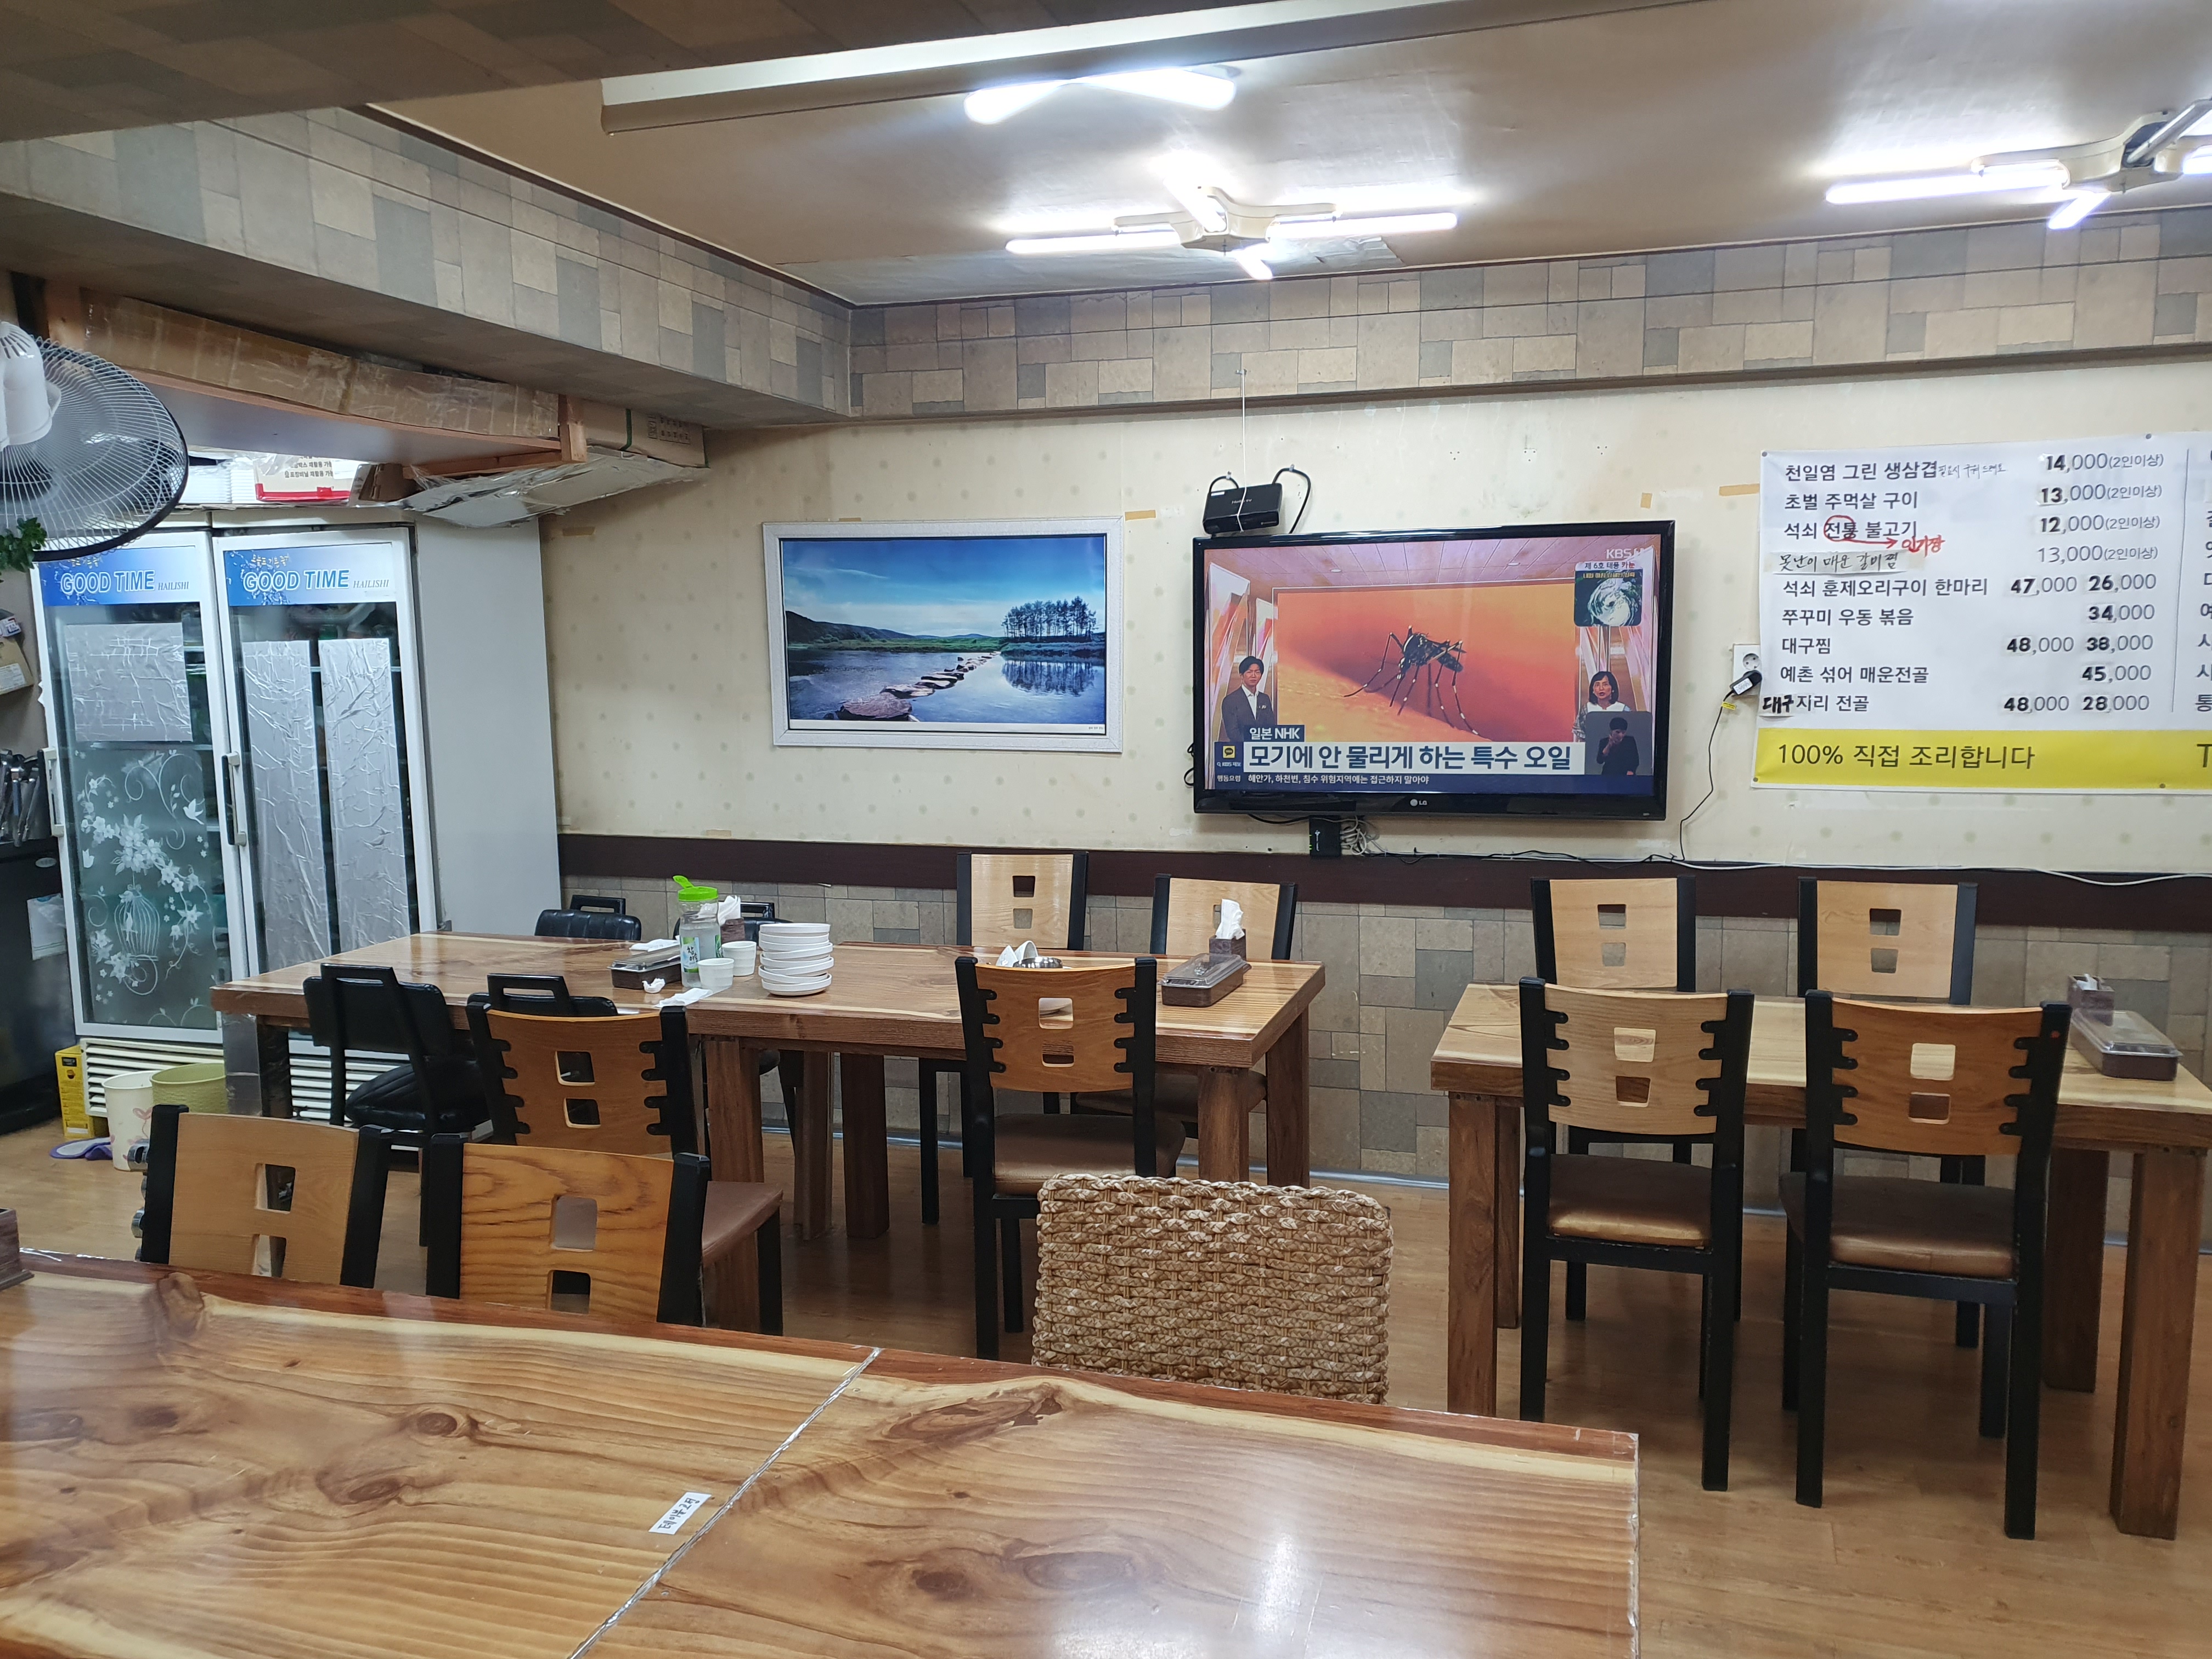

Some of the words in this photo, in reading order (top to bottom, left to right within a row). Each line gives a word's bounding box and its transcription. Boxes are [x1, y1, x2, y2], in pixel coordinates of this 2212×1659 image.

[1785, 464, 1836, 481] 천일염
[1842, 463, 1877, 480] 그린
[1884, 461, 1938, 480] 생삼겹
[1785, 493, 1818, 510] 초벌
[1825, 493, 1876, 510] 주먹살
[1883, 492, 1917, 509] 구이
[1784, 522, 1818, 539] 석쇠
[1825, 521, 1858, 539] 전통
[1865, 521, 1917, 539] 불고기
[1780, 554, 1817, 572] 못난이
[1824, 554, 1852, 573] 매운
[61, 572, 111, 594] GOOD
[114, 569, 155, 592] TIME
[158, 582, 189, 591] HAILISHI
[243, 571, 301, 592] GOOD
[303, 569, 350, 590] TIME
[353, 579, 389, 588] HAILISHI
[1784, 580, 1815, 597] 석쇠
[1822, 579, 1927, 596] 훈제오리구이
[1935, 578, 1988, 596] 한마리
[2010, 576, 2078, 596] 47,000
[2088, 574, 2157, 592] 26,000
[1781, 609, 1832, 626] 쭈꾸미
[1838, 609, 1872, 626] 우동
[1879, 608, 1914, 626] 볶음
[2088, 604, 2155, 623] 34,000
[1782, 637, 1831, 654] 대구찜
[2007, 636, 2074, 656] 48,000
[2086, 635, 2154, 653] 38,000
[1780, 666, 1814, 683] 예촌
[1820, 666, 1853, 684] 섞어
[1860, 666, 1929, 684] 매운전골
[2081, 665, 2152, 684] 45,000
[1836, 695, 1869, 712] 전골
[2004, 696, 2069, 713] 48,000
[2083, 695, 2150, 713] 28,000
[1249, 727, 1272, 740] 일본
[1274, 727, 1300, 740] NHK
[1249, 746, 1313, 769] 모기에
[1318, 746, 1342, 769] 안
[1346, 746, 1412, 769] 물리게
[1419, 746, 1465, 769] 하는
[1471, 746, 1518, 770] 특수
[1523, 746, 1571, 770] 오일
[1778, 744, 1843, 765] 100%
[1853, 745, 1899, 768] 직접
[1909, 745, 2035, 770] 조리합니다
[1248, 774, 1273, 783] 해안가,
[1302, 775, 1318, 783] 침수
[1370, 775, 1402, 784] 접근하지
